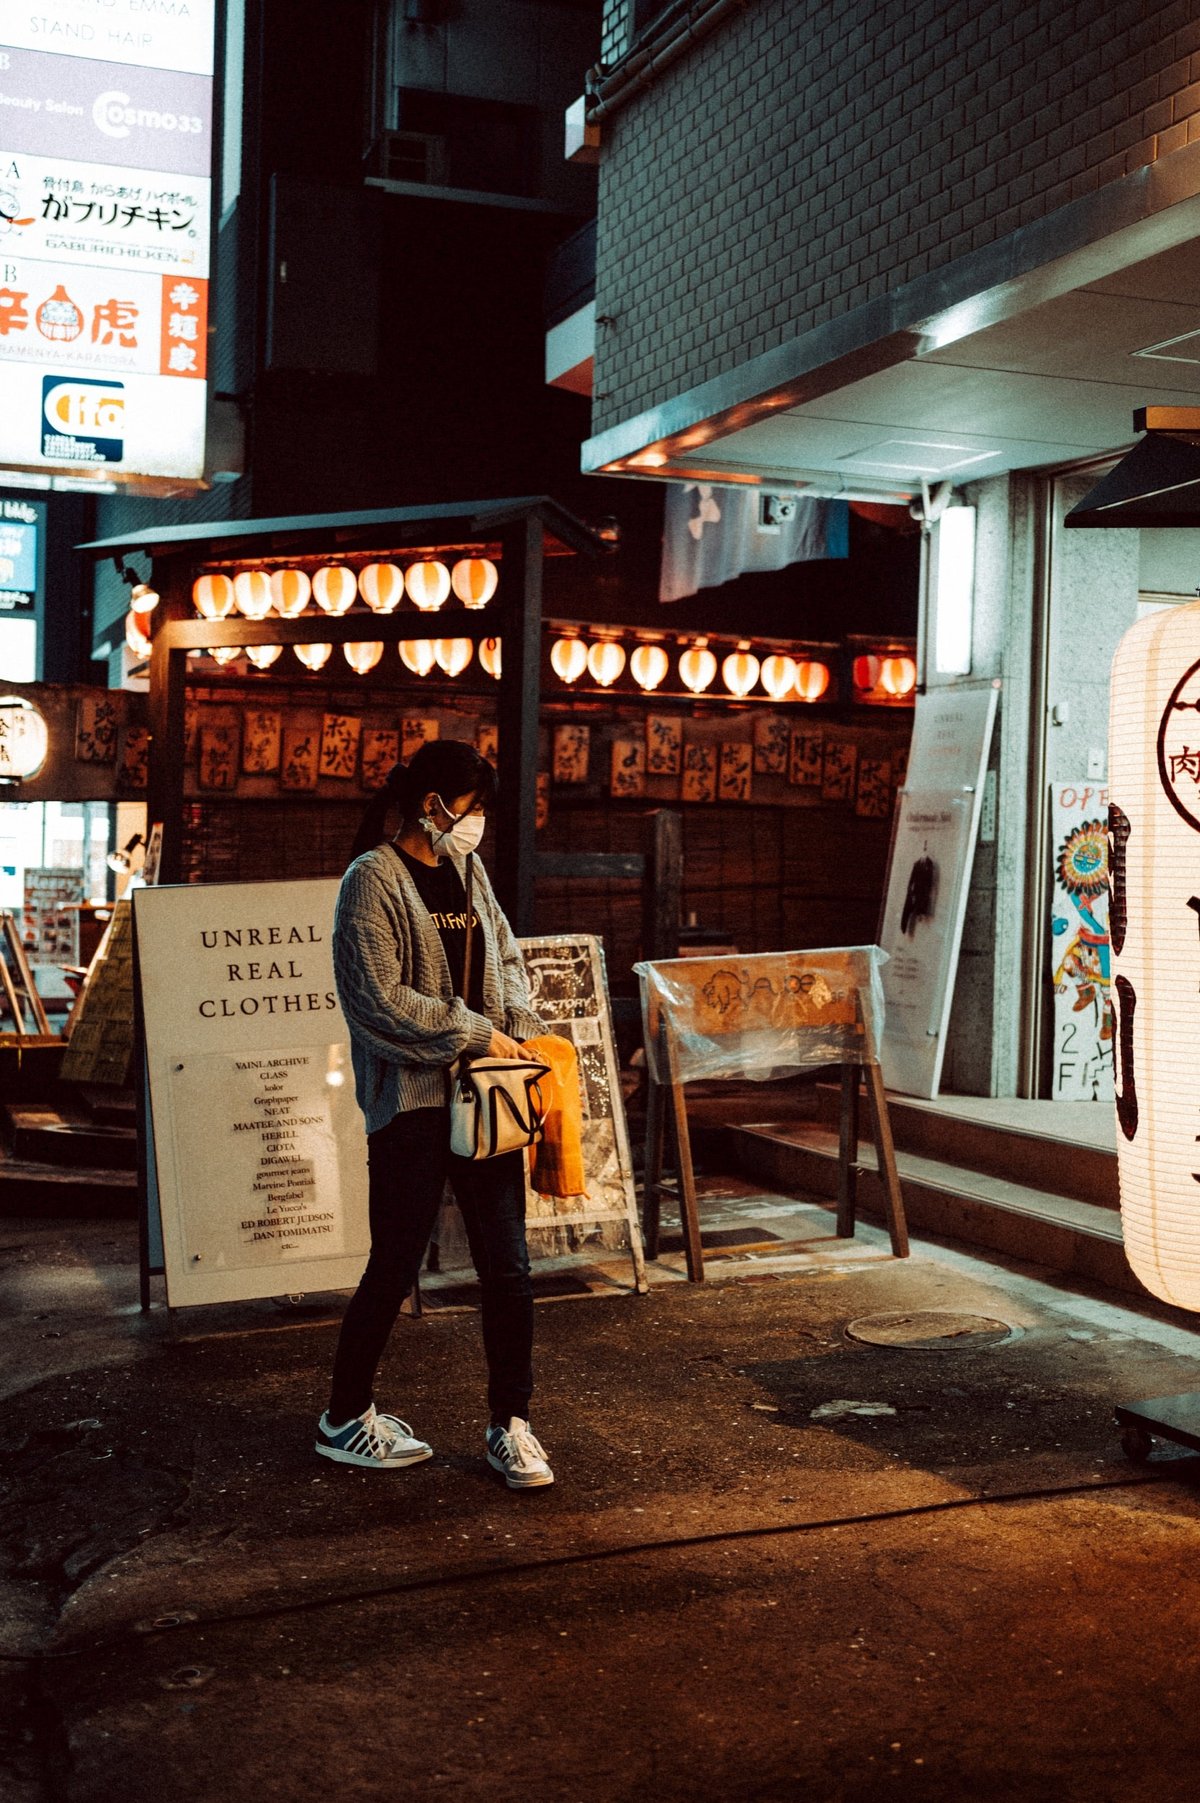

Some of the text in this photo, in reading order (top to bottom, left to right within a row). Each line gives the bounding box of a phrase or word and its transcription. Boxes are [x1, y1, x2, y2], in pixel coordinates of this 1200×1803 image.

[30, 16, 95, 41] STAND
[1060, 787, 1109, 810] OPE
[200, 925, 322, 949] UNREAL
[227, 961, 303, 982] REAL
[198, 992, 336, 1018] CLOTHES
[531, 997, 591, 1012] FACTORY
[267, 1057, 310, 1067] ARCHIVE
[260, 1071, 288, 1080] CLASS
[264, 1084, 284, 1092] kolor
[254, 1096, 299, 1106] Graphpaper
[264, 1107, 291, 1116] NEAT
[233, 1116, 324, 1131] MAATEE AND SONS
[261, 1131, 299, 1141] HERILL
[266, 1143, 295, 1152] CIOTA
[256, 1167, 311, 1180] gourmet jeans
[253, 1182, 286, 1192] Marvine
[266, 1206, 278, 1214] Le
[241, 1212, 334, 1229] ED ROBERT JUDSON
[278, 1225, 335, 1238] TOMIMATSU
